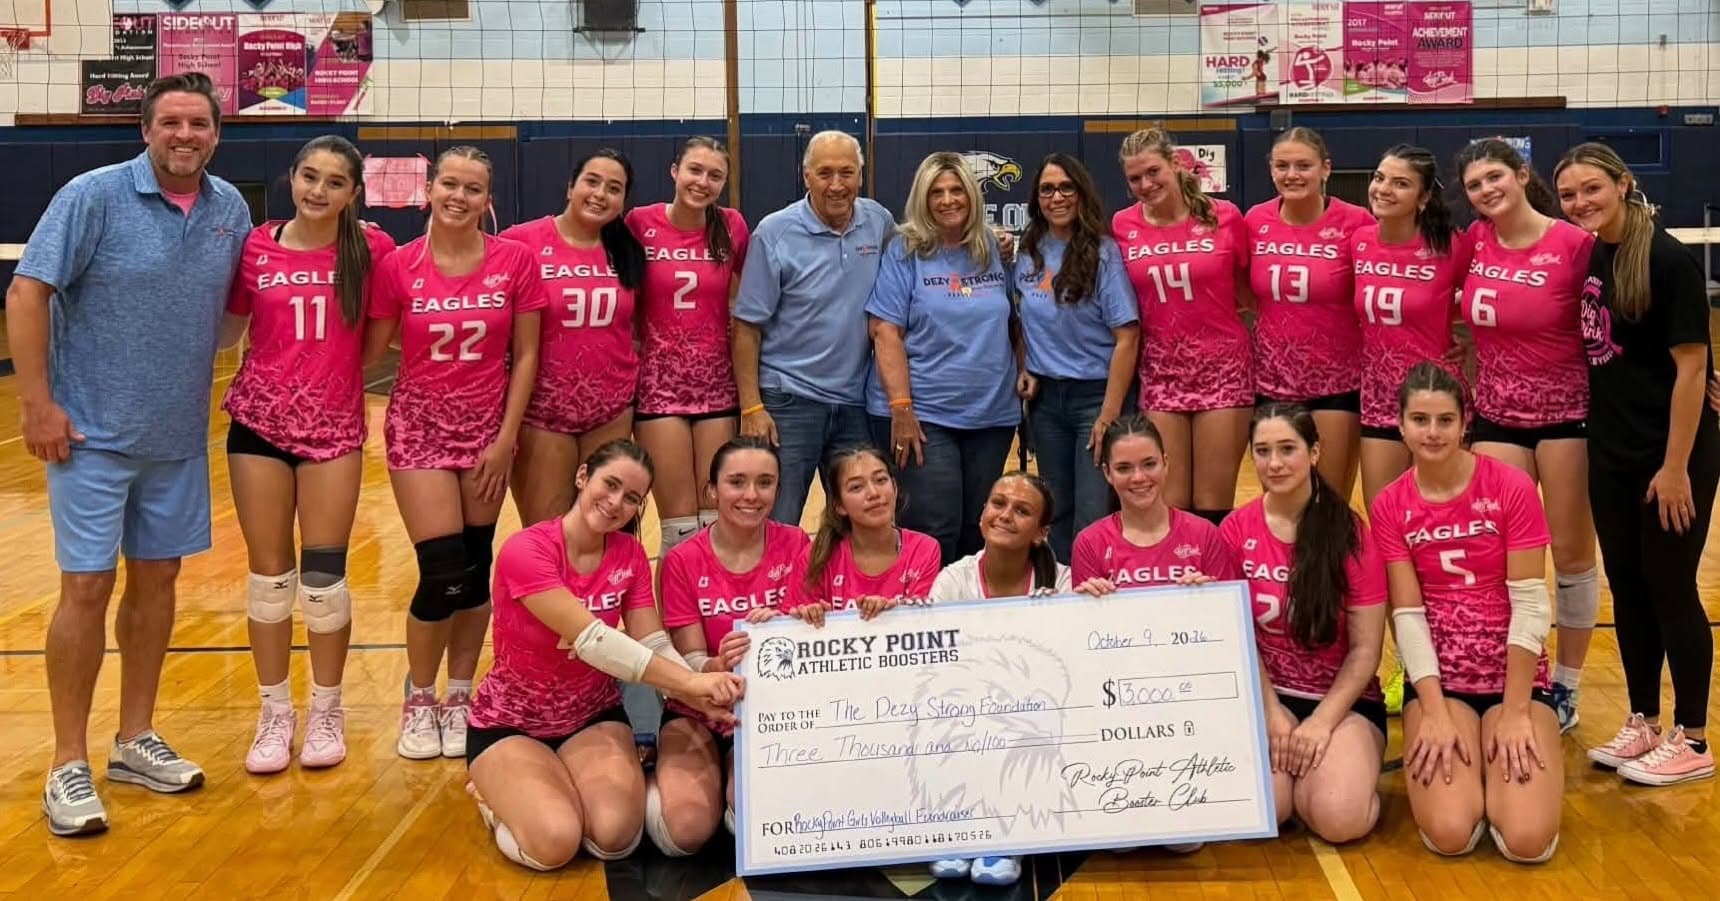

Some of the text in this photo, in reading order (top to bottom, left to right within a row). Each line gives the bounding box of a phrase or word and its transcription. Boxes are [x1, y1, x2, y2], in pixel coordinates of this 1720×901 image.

[1412, 27, 1468, 38] ACHIEVEMENT
[1417, 38, 1464, 49] AWARD
[1206, 56, 1250, 68] HARD
[1198, 148, 1215, 162] Dig
[1128, 238, 1215, 263] EAGLES
[1255, 241, 1339, 260] EAGLES
[541, 264, 619, 280] EAGLE
[1147, 263, 1193, 303] 14
[1354, 259, 1437, 281] EAGLES
[673, 271, 698, 310] 2
[1267, 264, 1310, 303] 13
[412, 291, 506, 313] EAGLES
[561, 287, 617, 328] 30
[1363, 285, 1405, 326] 19
[1471, 287, 1497, 327] 6
[288, 295, 327, 341] 11
[429, 320, 487, 362] 22
[1404, 520, 1500, 549] EAGLES
[1110, 565, 1198, 588] AGLES
[1243, 560, 1289, 583] EAG
[1439, 549, 1476, 586] 5
[797, 629, 960, 659] ROCKY POINT
[1088, 630, 1134, 650] October
[797, 650, 960, 676] ATHLETIC BOOSTERS
[1102, 679, 1118, 709] $
[758, 708, 820, 722] PAY TO THE
[829, 695, 1047, 729] The Dezy Strong Foundation
[758, 720, 815, 734] ORDER OF
[1101, 723, 1175, 742] DOLLARS
[760, 742, 824, 765] Three
[833, 734, 918, 760] Thousand
[1060, 753, 1236, 789] Rocky Point Athletic
[1098, 782, 1207, 813] Booster Club
[762, 820, 793, 838] FOR
[793, 812, 824, 839] Rocky
